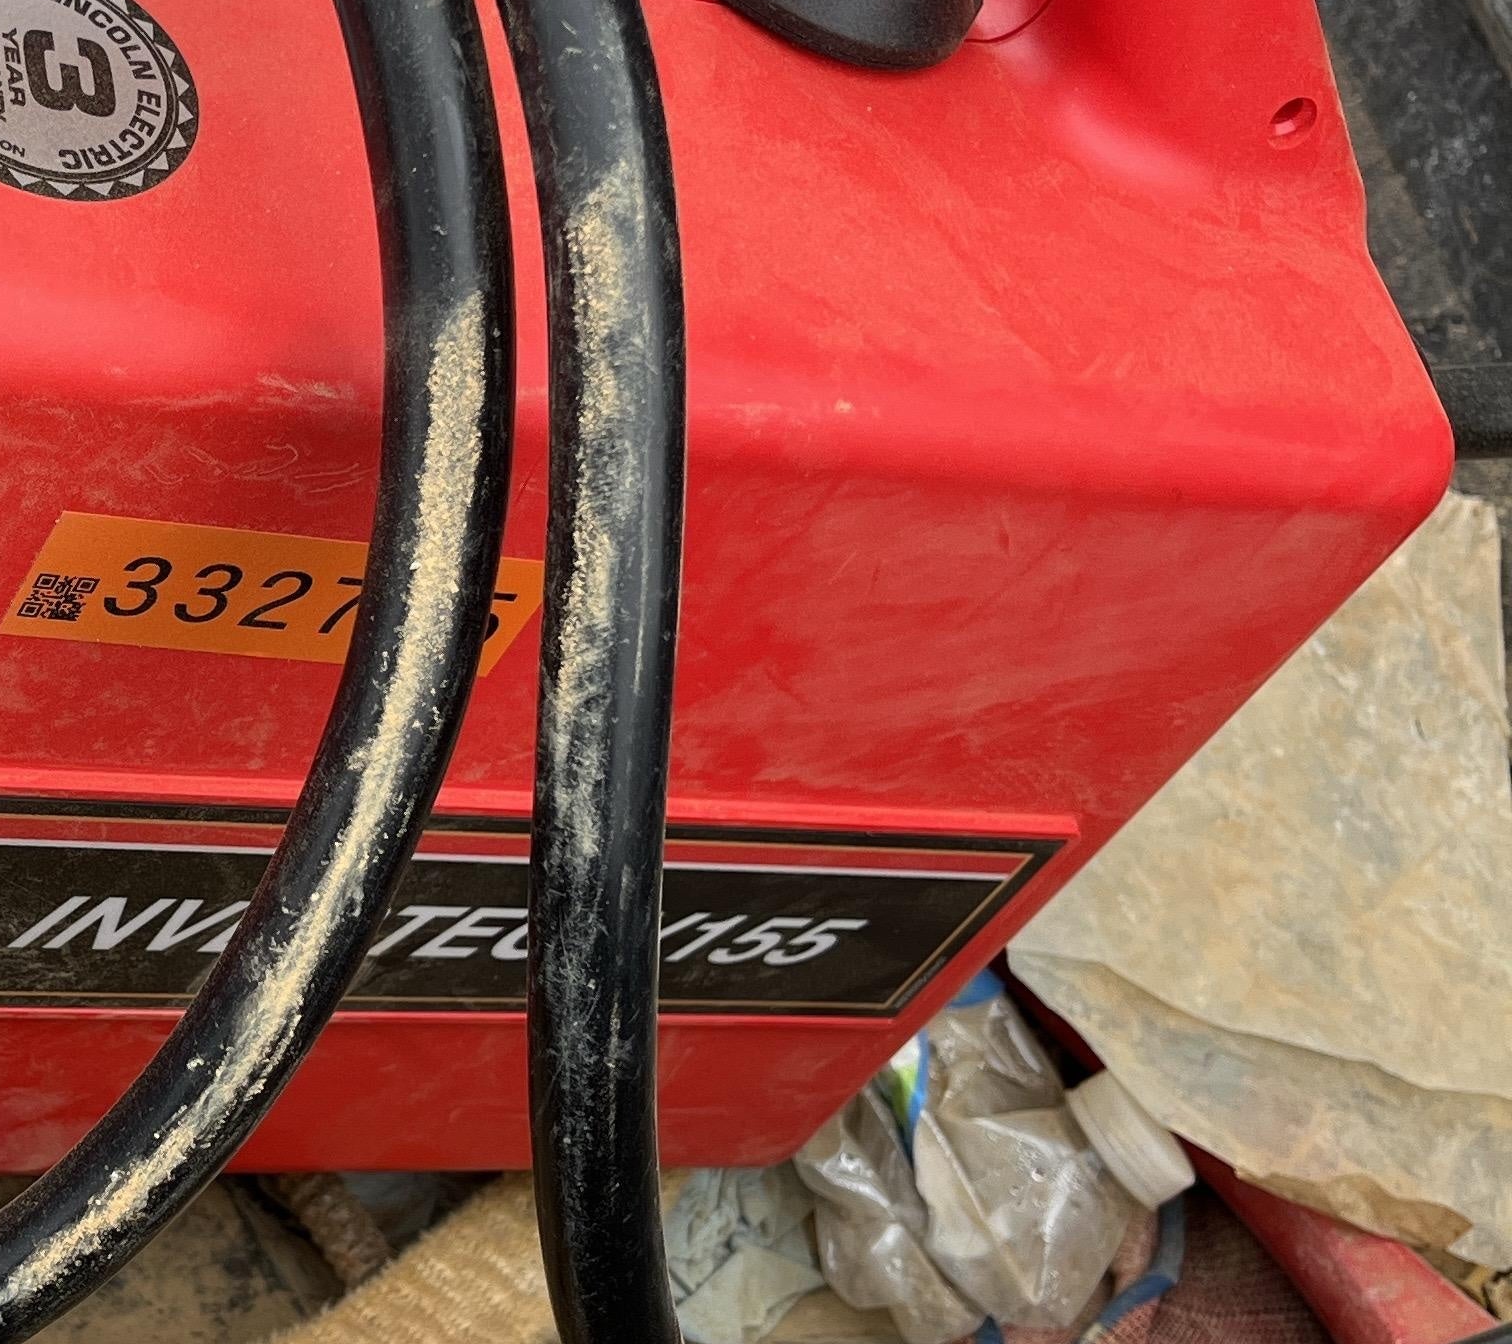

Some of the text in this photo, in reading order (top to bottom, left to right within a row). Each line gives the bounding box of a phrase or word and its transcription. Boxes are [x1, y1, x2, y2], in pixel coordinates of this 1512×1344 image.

[1, 27, 27, 107] YEAR
[22, 29, 117, 118] 3
[58, 88, 162, 171] ELECTRIC
[103, 556, 518, 644] 3327
[6, 895, 529, 962] INVTE
